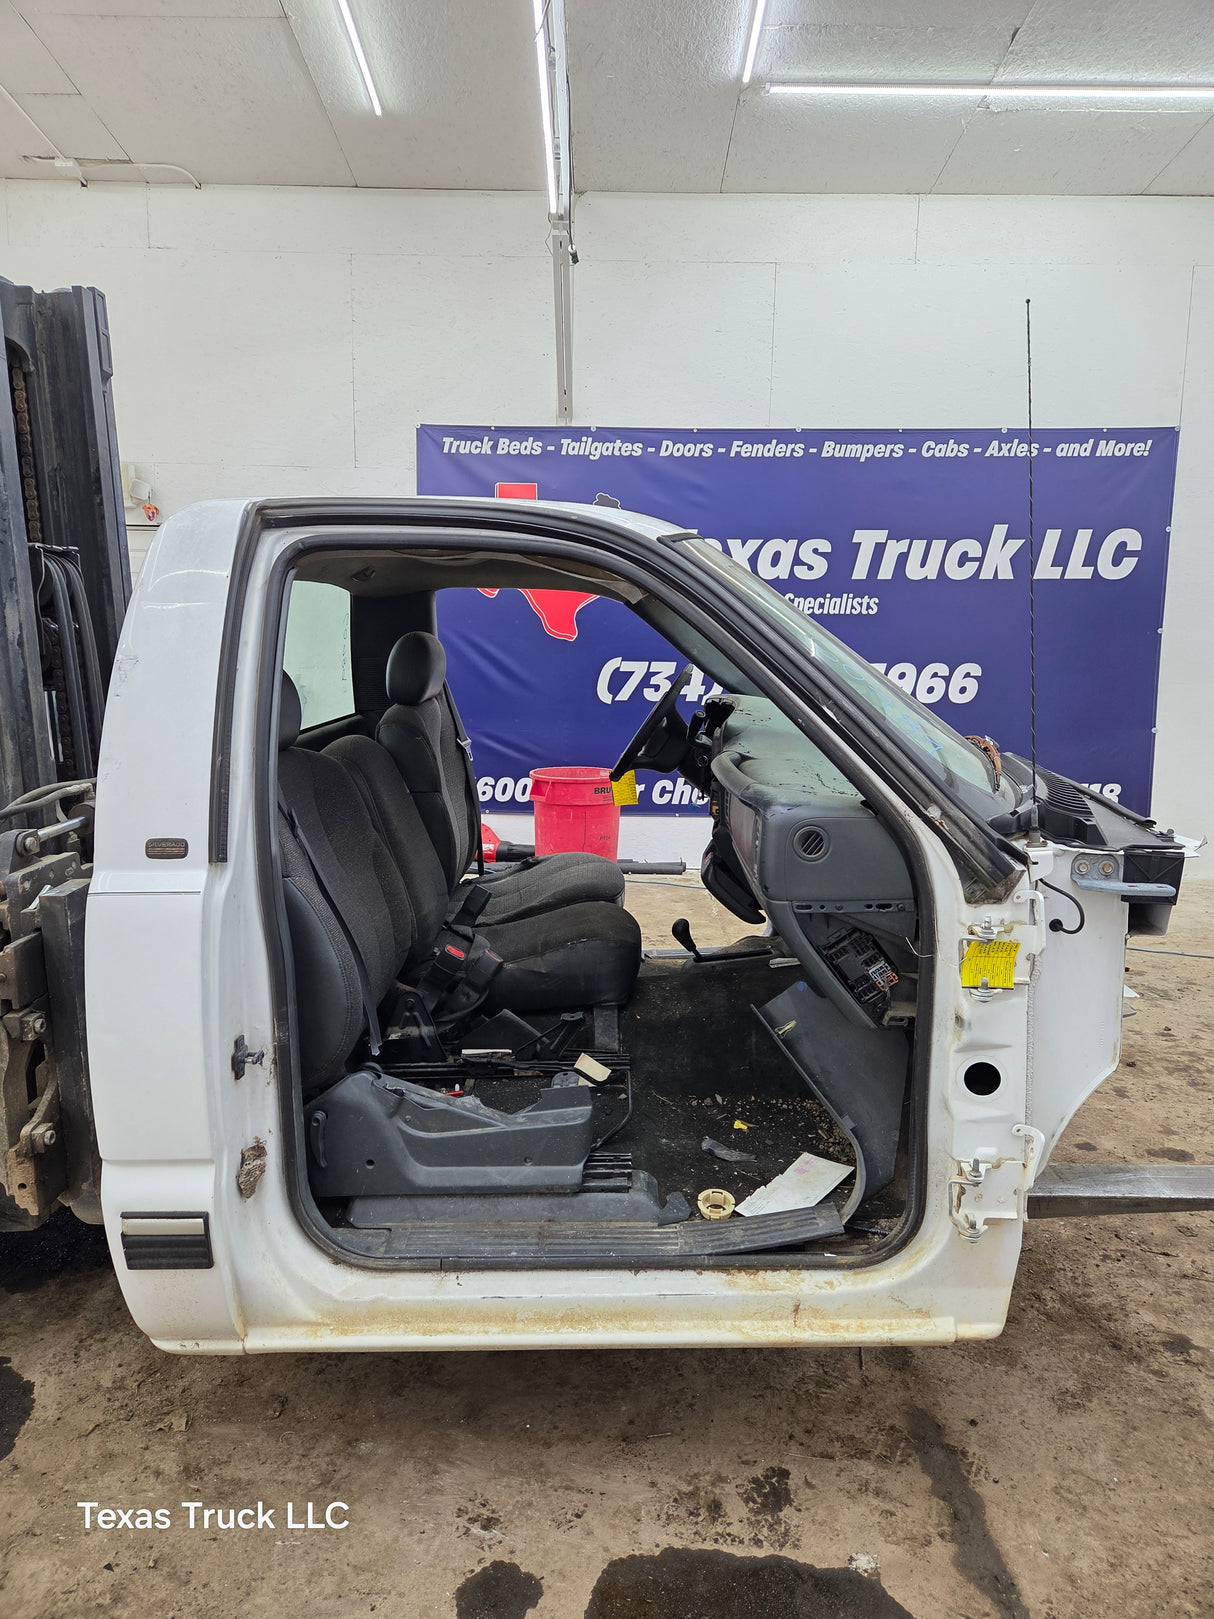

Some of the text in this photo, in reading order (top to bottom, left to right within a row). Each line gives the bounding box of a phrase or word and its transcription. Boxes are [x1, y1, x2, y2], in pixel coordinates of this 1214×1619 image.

[442, 437, 493, 455] Truck
[497, 437, 542, 455] Beds
[561, 437, 643, 460] Tailgates
[660, 440, 713, 457] Doors
[730, 440, 804, 458] Fenders
[821, 441, 904, 462] Bumpers
[921, 440, 969, 458] Cabs
[985, 438, 1039, 457] Axles
[1056, 440, 1089, 457] and
[1095, 439, 1152, 457] More!
[684, 524, 1143, 581] xas Truck LLC
